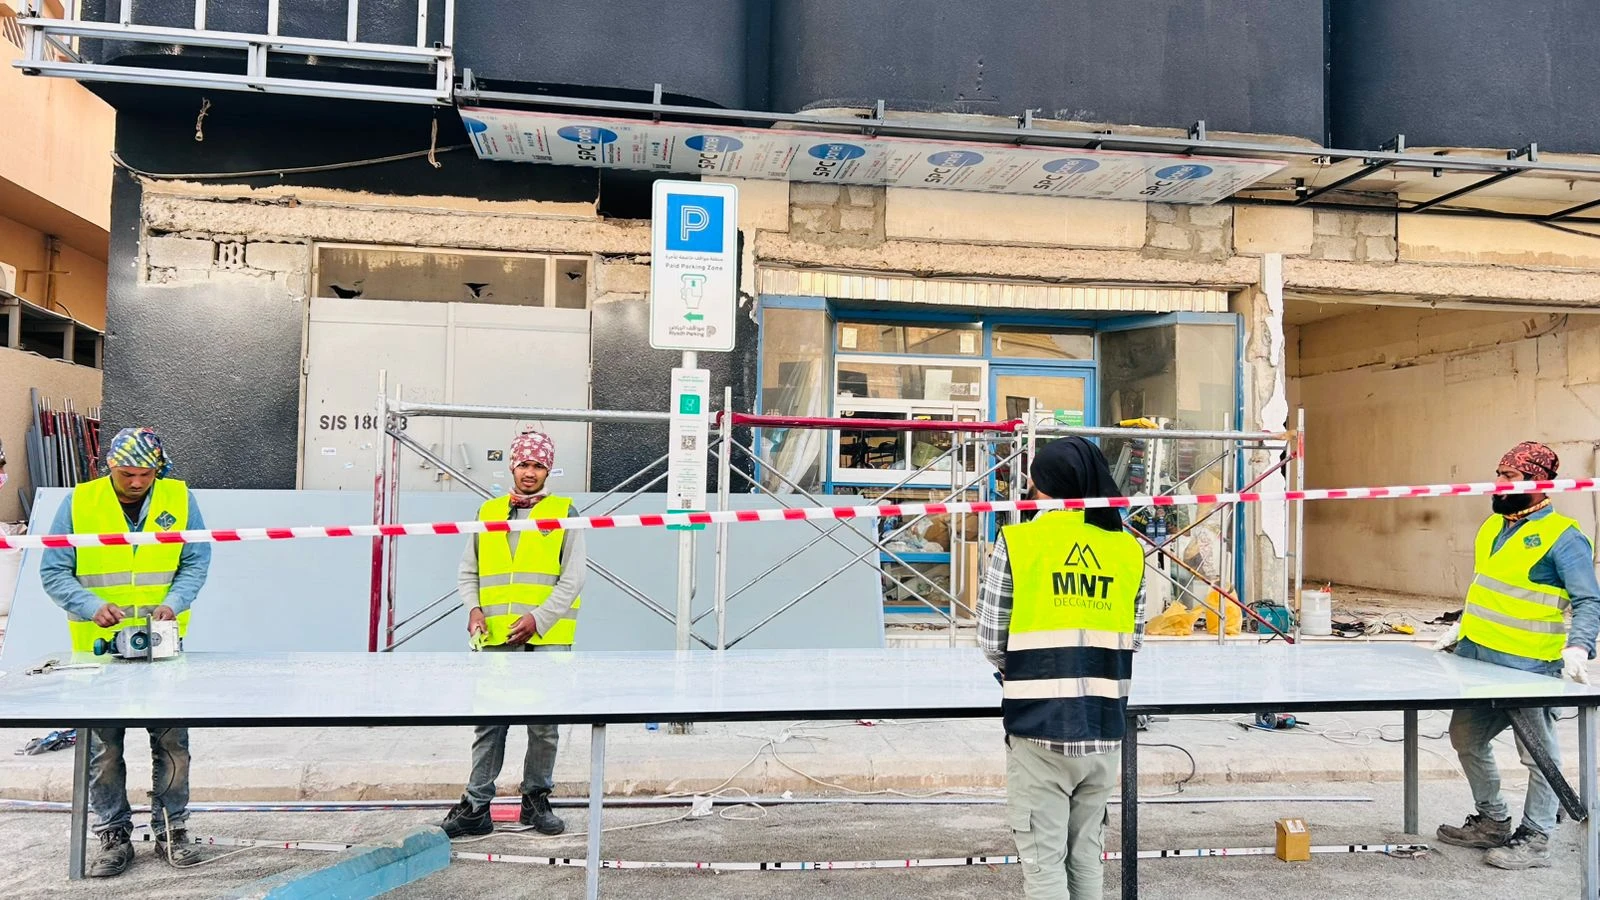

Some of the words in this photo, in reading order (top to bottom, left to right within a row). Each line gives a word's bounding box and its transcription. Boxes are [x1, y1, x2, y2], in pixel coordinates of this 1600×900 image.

[577, 143, 597, 161] SPC
[697, 153, 718, 169] SPC
[813, 161, 836, 177] SPC
[924, 168, 951, 183] SPC
[1033, 174, 1063, 189] SPC
[1140, 181, 1172, 195] SPC
[681, 205, 710, 241] P
[681, 263, 706, 271] Parking
[319, 414, 347, 430] S/S
